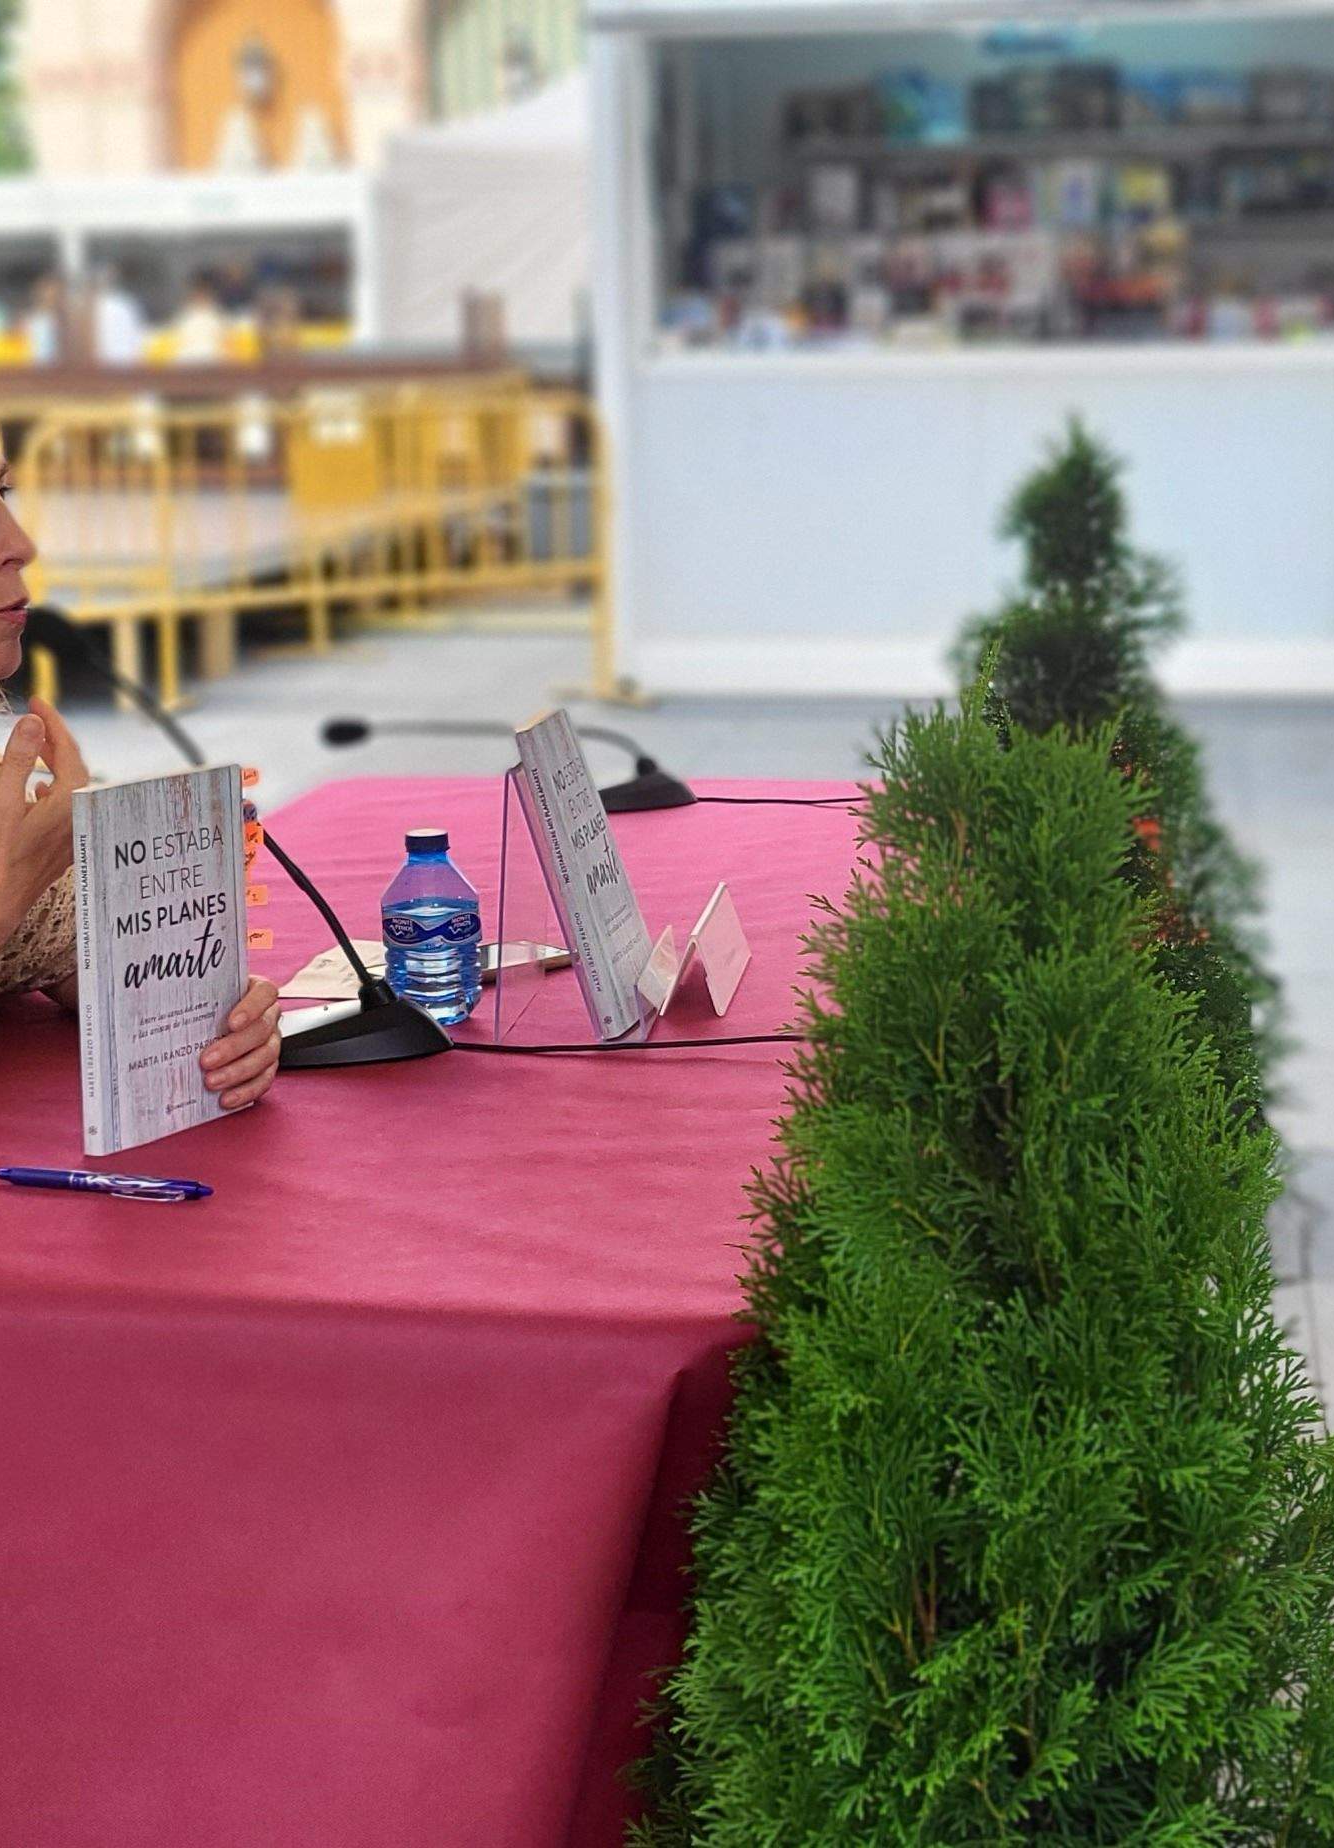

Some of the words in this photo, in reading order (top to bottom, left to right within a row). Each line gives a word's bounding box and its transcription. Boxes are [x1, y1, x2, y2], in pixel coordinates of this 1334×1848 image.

[114, 840, 146, 869] NO
[152, 824, 224, 860] ESTABA
[140, 864, 204, 899] ENTRE
[117, 910, 152, 939] MIS
[157, 892, 227, 929] PLANES
[124, 919, 226, 988] amarte
[128, 1055, 158, 1072] MARTA
[160, 1044, 193, 1064] IRANZO
